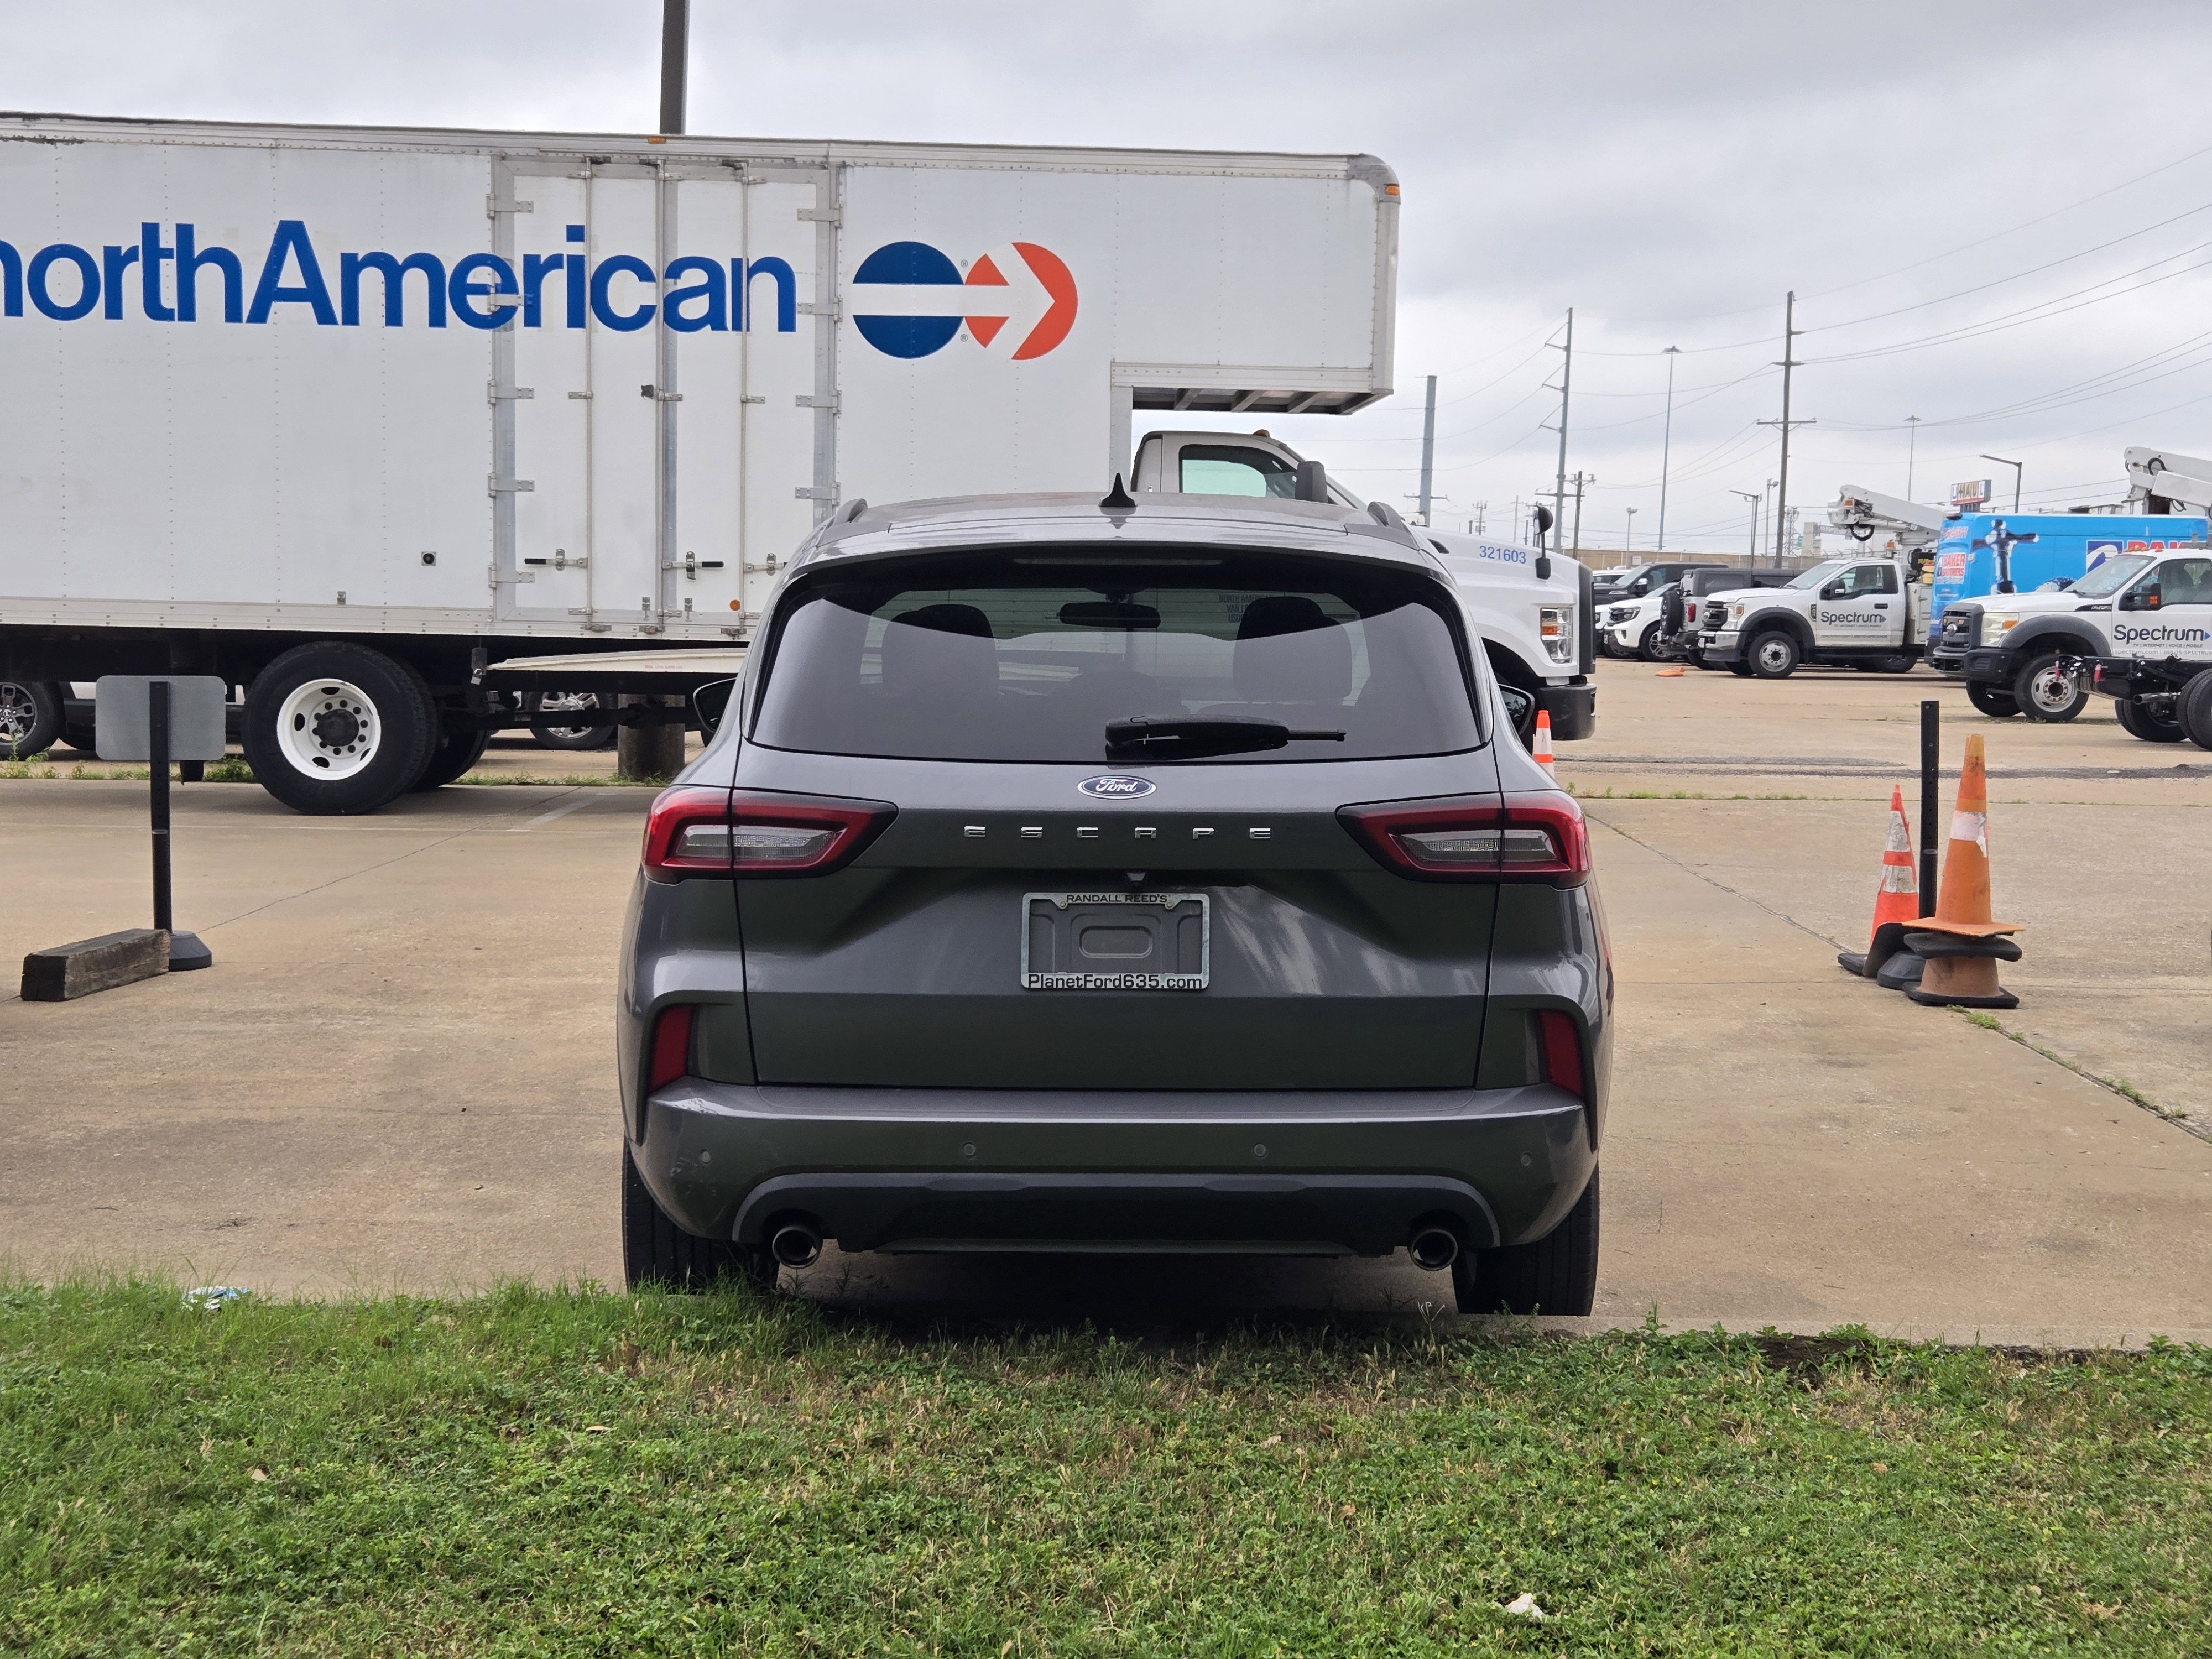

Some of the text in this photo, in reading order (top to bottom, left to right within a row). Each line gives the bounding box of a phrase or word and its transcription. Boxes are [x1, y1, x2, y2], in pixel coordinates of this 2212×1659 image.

[1479, 545, 1526, 564] 321603
[1820, 611, 1882, 625] Spectrum
[2114, 624, 2204, 645] Spectrum
[1095, 778, 1138, 792] Ford
[964, 826, 1271, 839] ESCAPE
[1066, 894, 1168, 903] RANDALL REED'S
[1027, 974, 1203, 989] PlanetFord635.com
